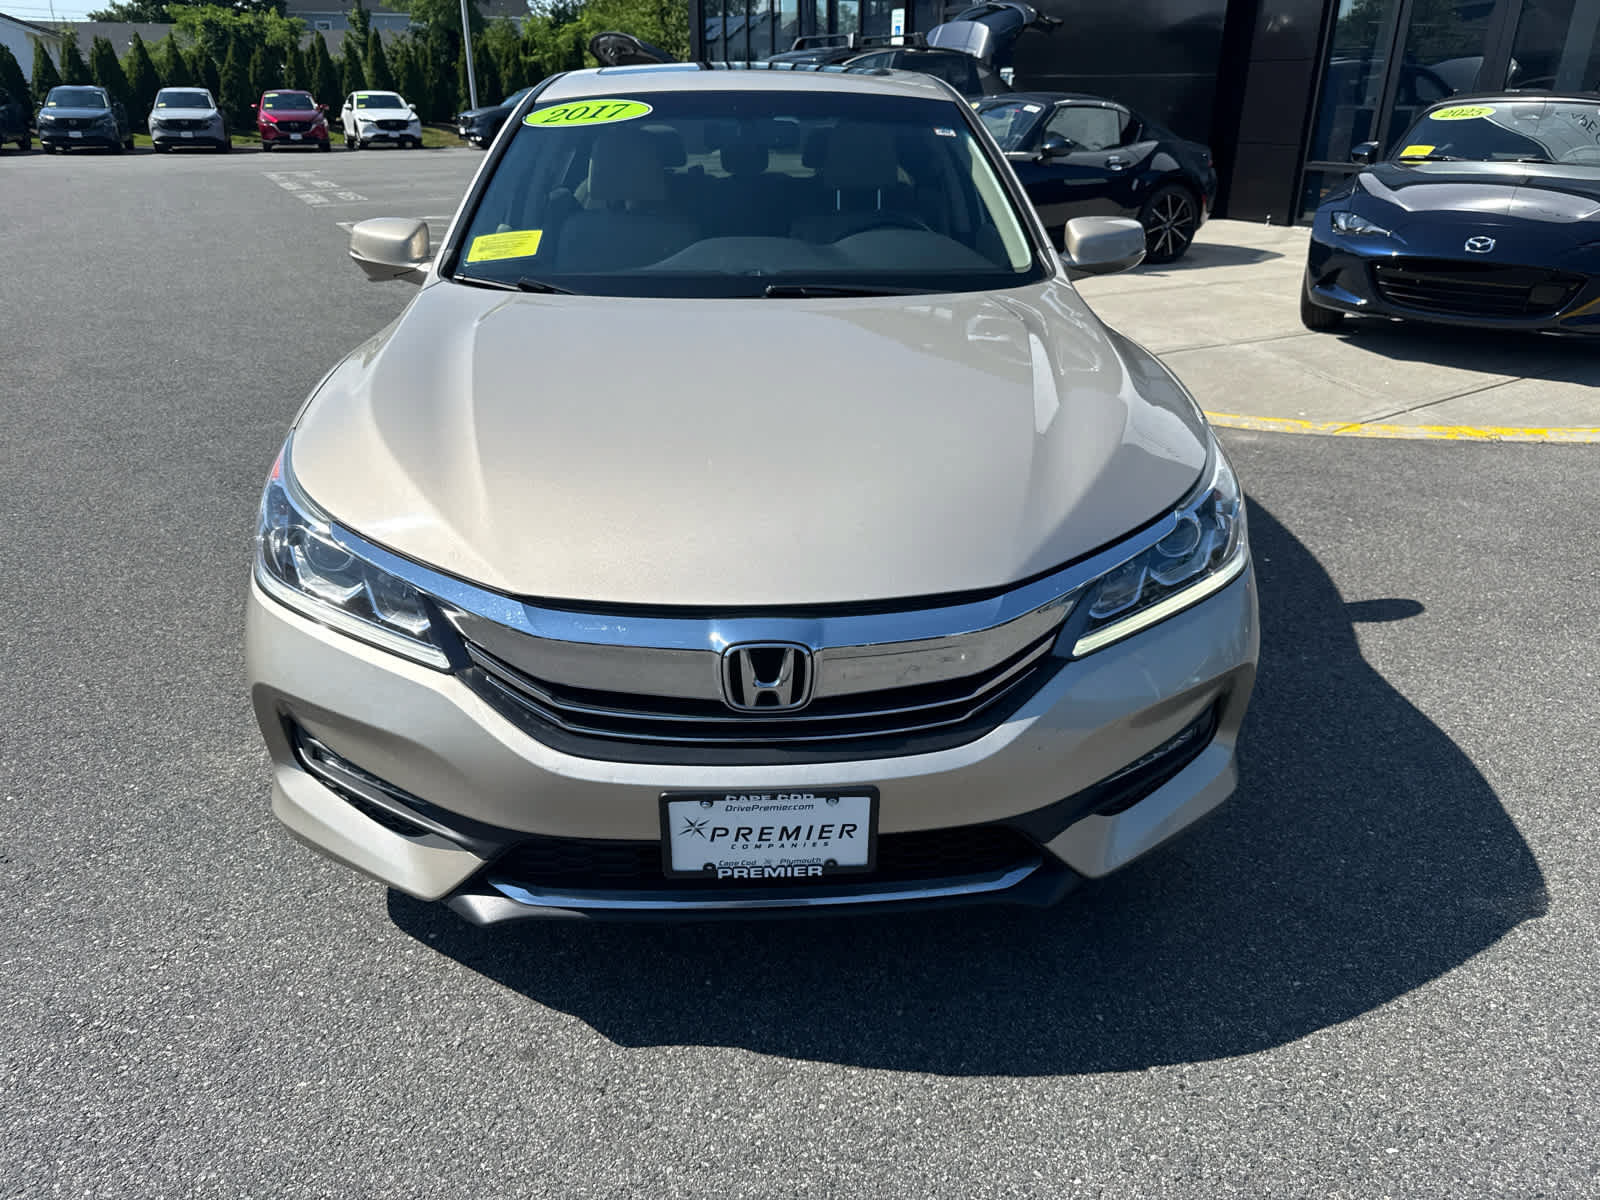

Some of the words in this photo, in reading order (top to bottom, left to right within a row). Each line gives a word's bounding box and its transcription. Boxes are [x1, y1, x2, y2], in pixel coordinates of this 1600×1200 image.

[541, 103, 631, 124] 2017
[725, 803, 815, 812] DrivePremier.com
[709, 823, 858, 842] PREMIER
[730, 841, 830, 850] COMPANIES
[779, 857, 822, 866] Plymouth
[717, 865, 823, 879] PREMIER
